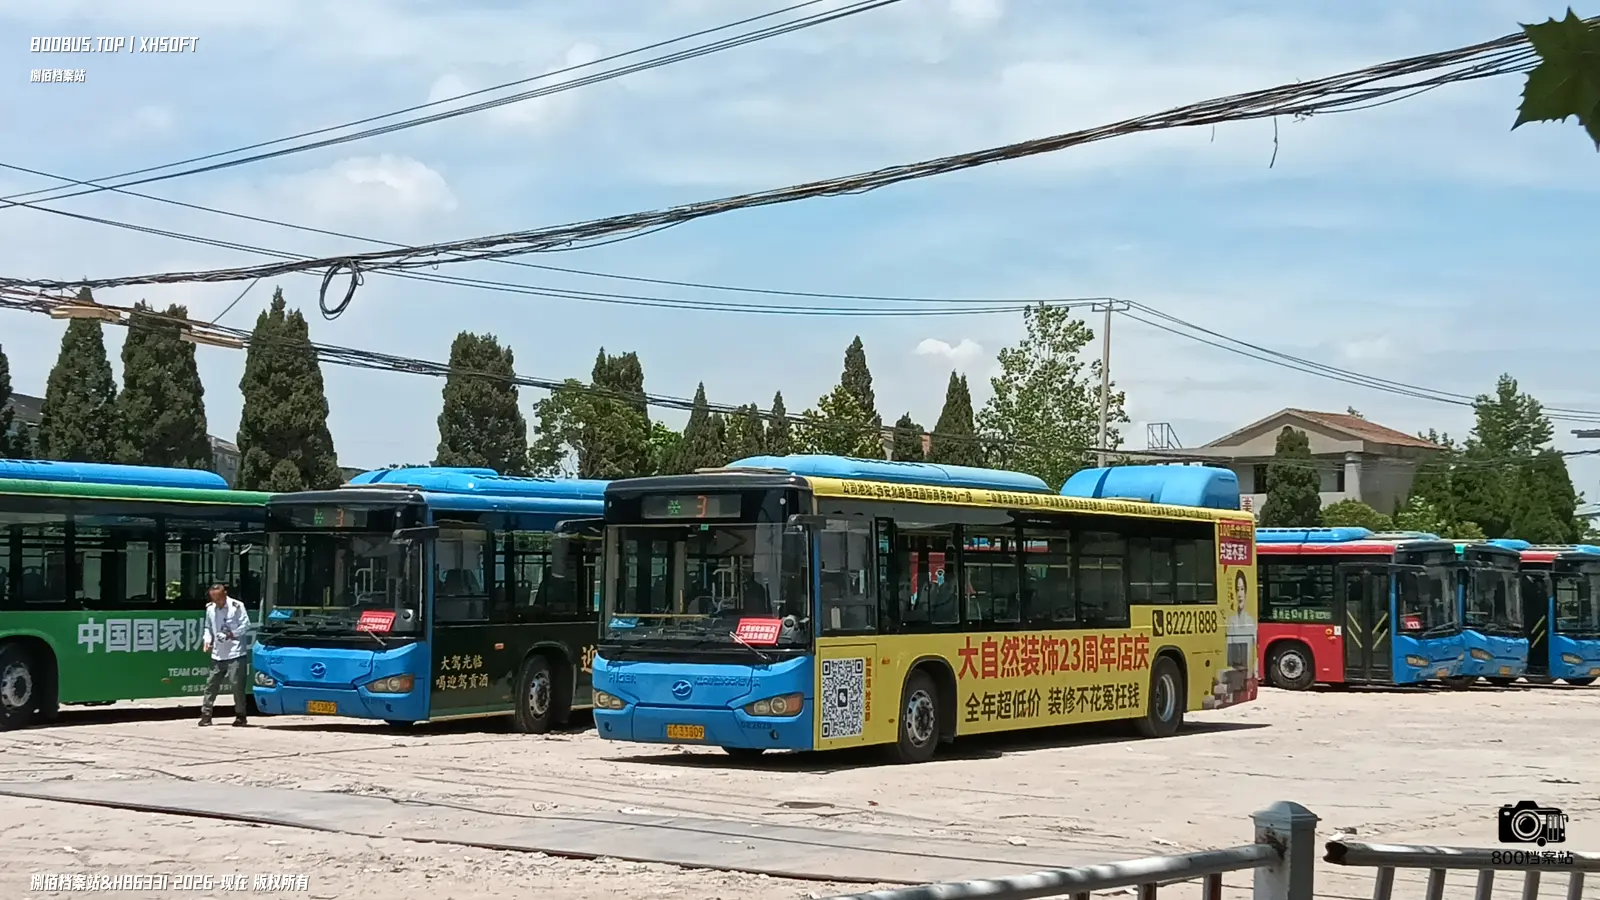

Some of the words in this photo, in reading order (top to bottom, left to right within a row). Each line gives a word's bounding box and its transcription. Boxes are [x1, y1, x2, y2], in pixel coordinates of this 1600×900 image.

[1165, 610, 1218, 635] 82221888
[440, 653, 484, 671] 大驾光临
[957, 632, 1150, 681] 大自然装饰23周年店庆
[168, 667, 190, 677] TEAM
[435, 672, 490, 691] 喝迎驾贡酒
[965, 688, 1041, 723] 全年超低价
[1048, 682, 1140, 715] 装修不花冤枉钱
